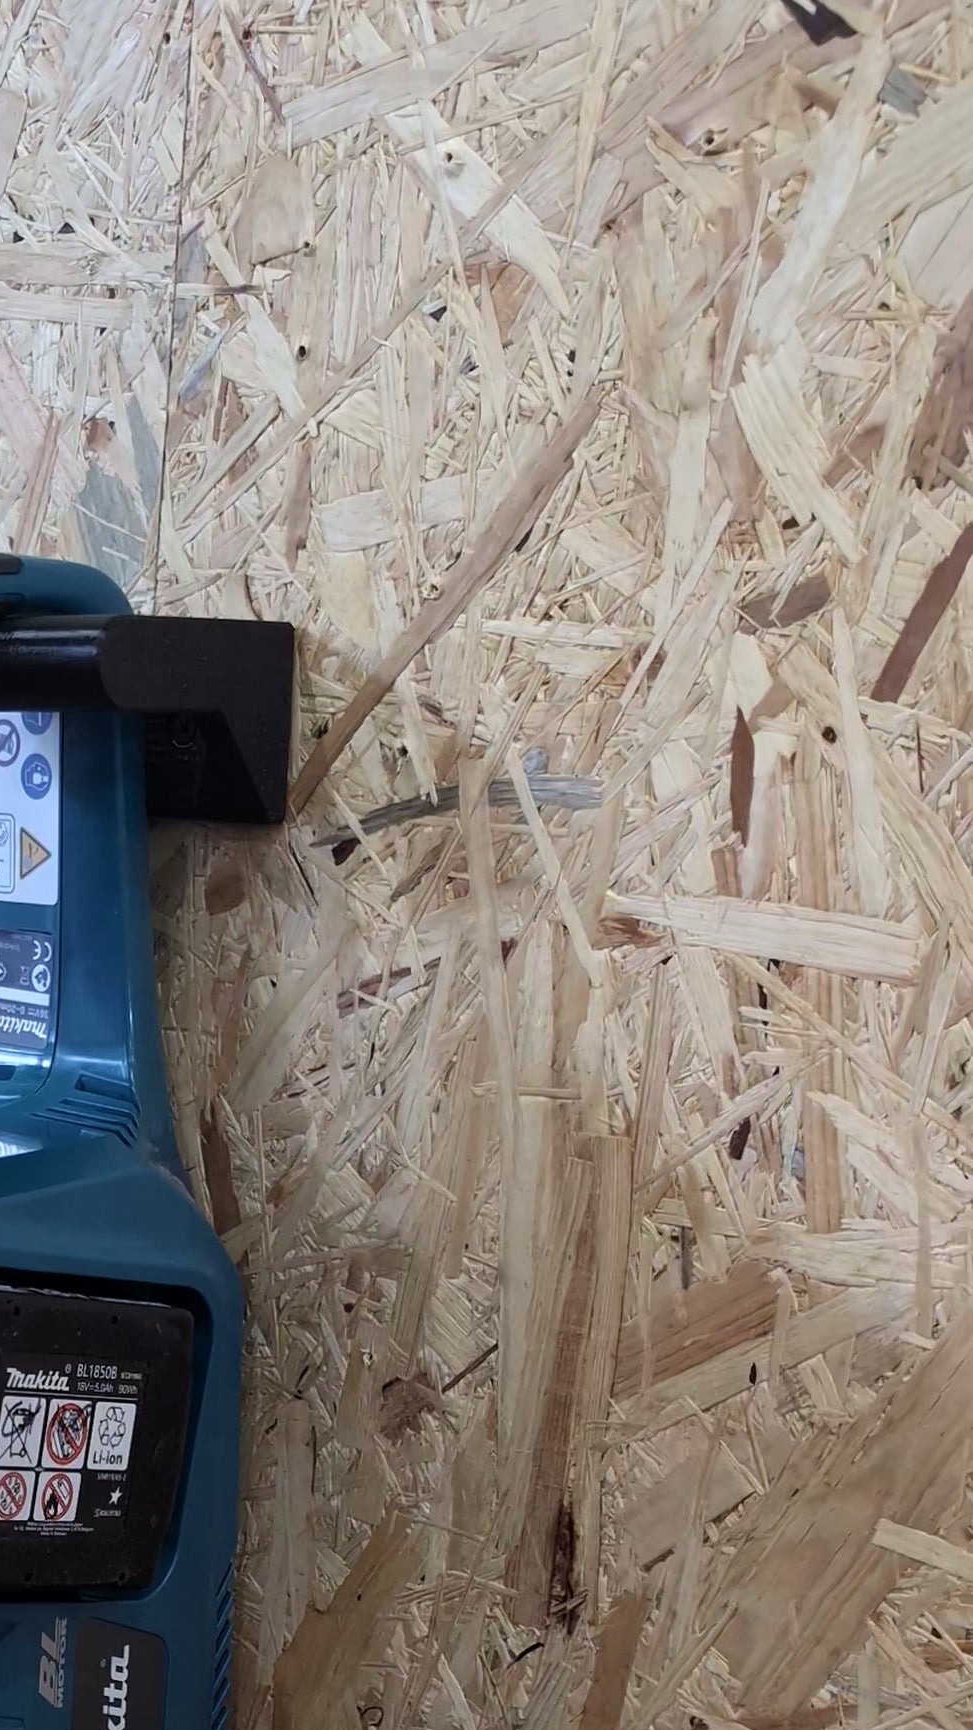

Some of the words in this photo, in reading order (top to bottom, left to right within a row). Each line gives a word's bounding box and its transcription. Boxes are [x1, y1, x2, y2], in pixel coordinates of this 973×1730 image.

[77, 1363, 118, 1380] BL1850B
[93, 1451, 123, 1465] Li-ion
[57, 1617, 68, 1708] MOTOR
